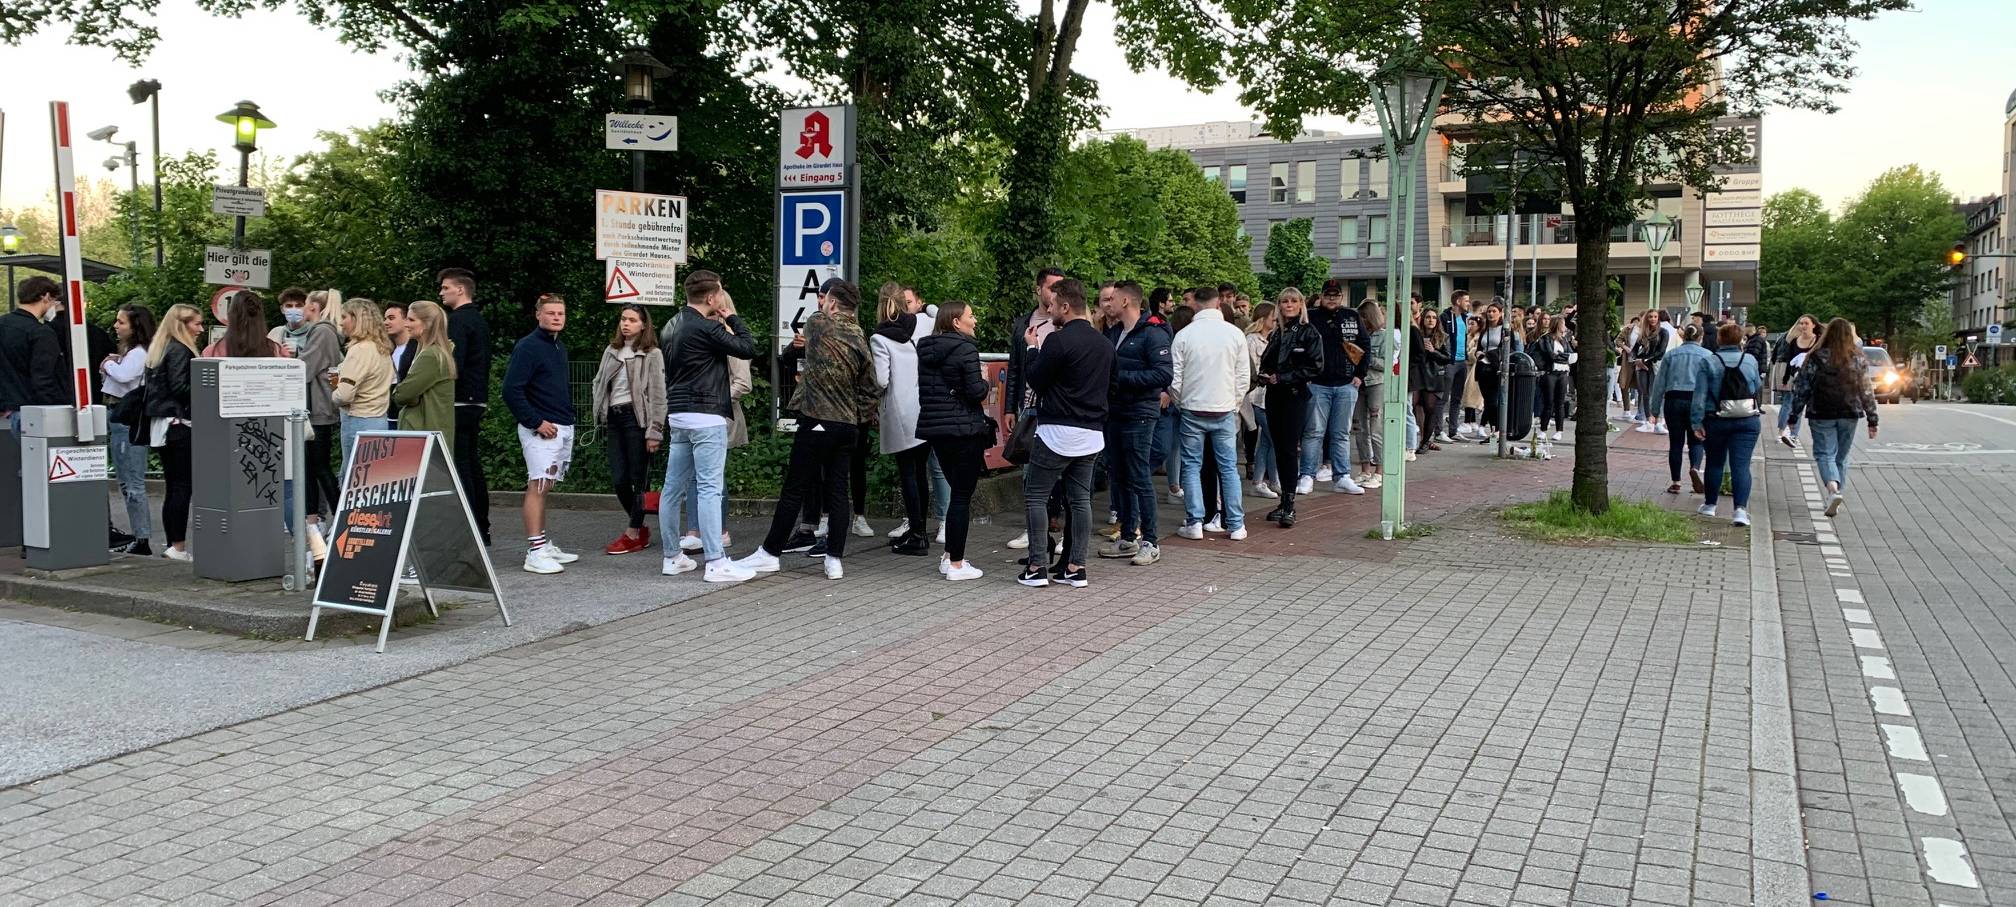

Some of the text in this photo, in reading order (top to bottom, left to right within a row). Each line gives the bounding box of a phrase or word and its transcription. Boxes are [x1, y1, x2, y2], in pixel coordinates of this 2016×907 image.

[609, 119, 644, 129] Willecke
[800, 172, 843, 183] Eingang 5
[602, 194, 681, 218] PARKEN
[611, 218, 636, 230] Stunde
[638, 220, 684, 234] gebührenfrei
[795, 203, 831, 257] P
[617, 233, 682, 245] Parkscheinentwertung
[621, 241, 660, 251] teilnehmende
[661, 244, 681, 252] Mieter
[207, 252, 268, 267] Hier gilt die
[616, 259, 673, 270] Eingeschränkter
[629, 270, 673, 279] Winterdienst
